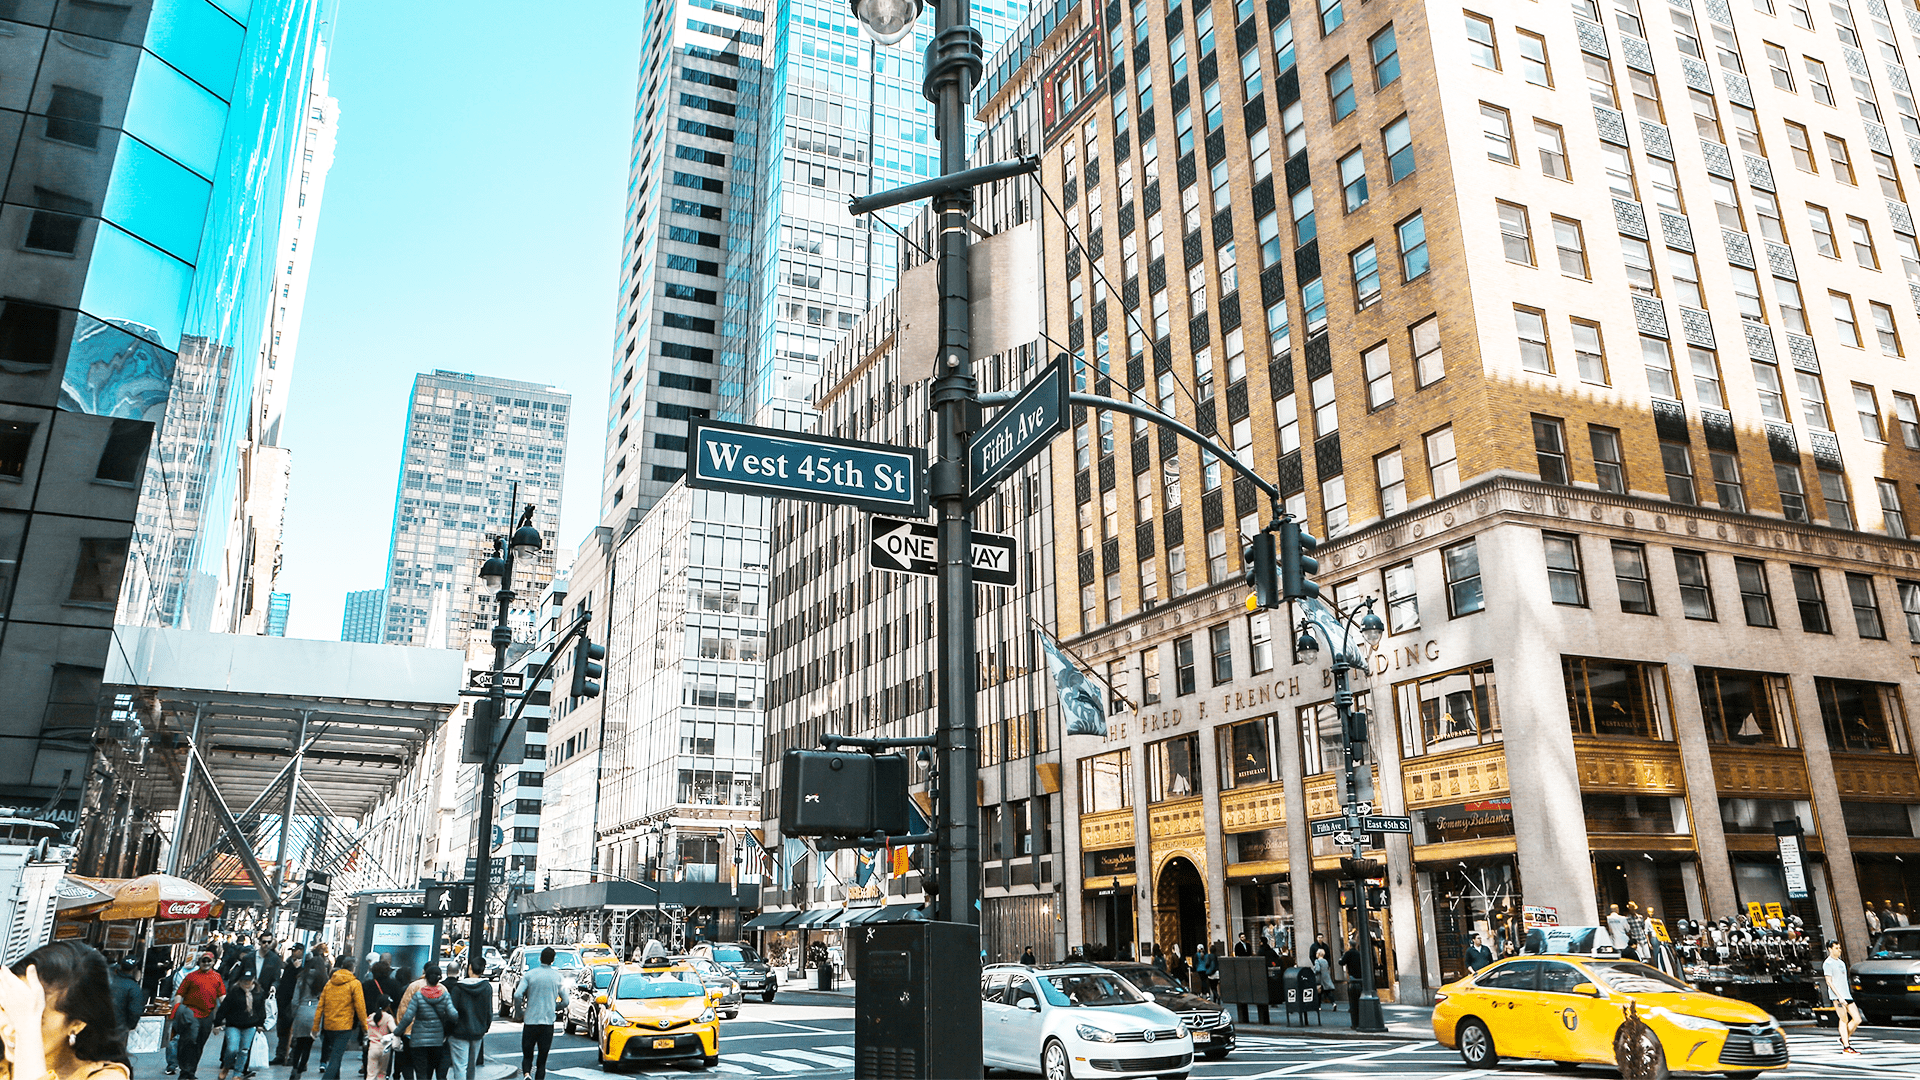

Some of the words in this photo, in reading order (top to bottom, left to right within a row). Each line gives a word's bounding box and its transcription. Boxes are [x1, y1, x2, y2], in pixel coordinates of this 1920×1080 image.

[981, 426, 1014, 475] Fifth
[1016, 405, 1044, 446] Ave
[705, 440, 789, 479] West
[797, 454, 865, 488] 45th
[874, 463, 905, 493] St
[887, 535, 934, 560] ONE
[1103, 723, 1127, 744] HE
[1142, 709, 1181, 734] FRED
[1223, 676, 1299, 713] FRENCH
[1322, 639, 1440, 689] BIDING
[1432, 729, 1471, 741] RESTAURANT
[1316, 823, 1331, 833] Fifth
[1331, 822, 1342, 831] Ave
[1366, 820, 1383, 829] East
[1383, 820, 1399, 829] 45th
[1399, 821, 1408, 830] St
[1563, 1011, 1577, 1029] T
